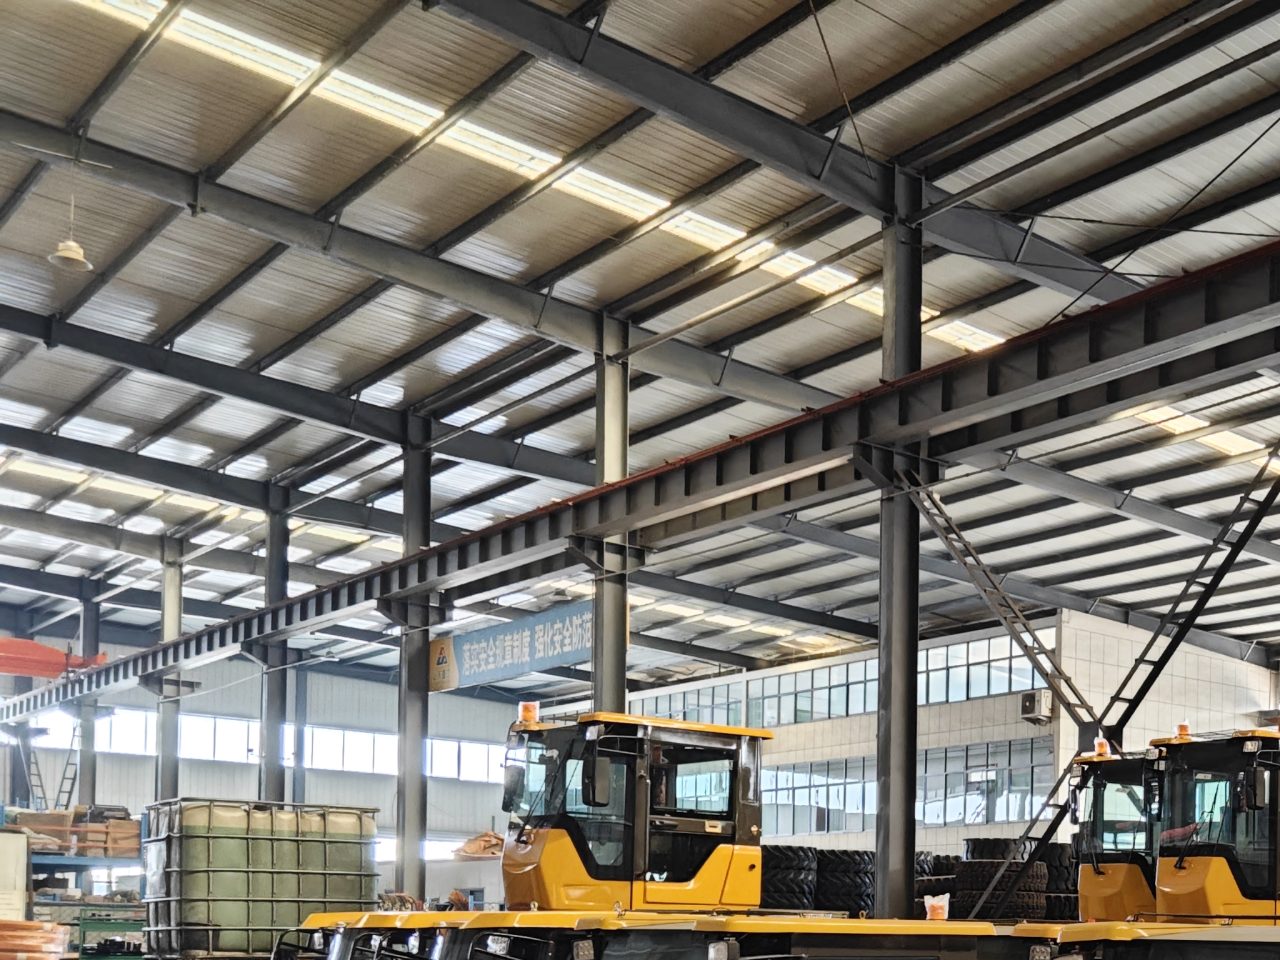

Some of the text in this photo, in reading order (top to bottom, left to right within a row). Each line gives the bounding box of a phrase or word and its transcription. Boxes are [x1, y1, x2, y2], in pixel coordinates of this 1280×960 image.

[463, 628, 531, 676] 落实安全规章制度
